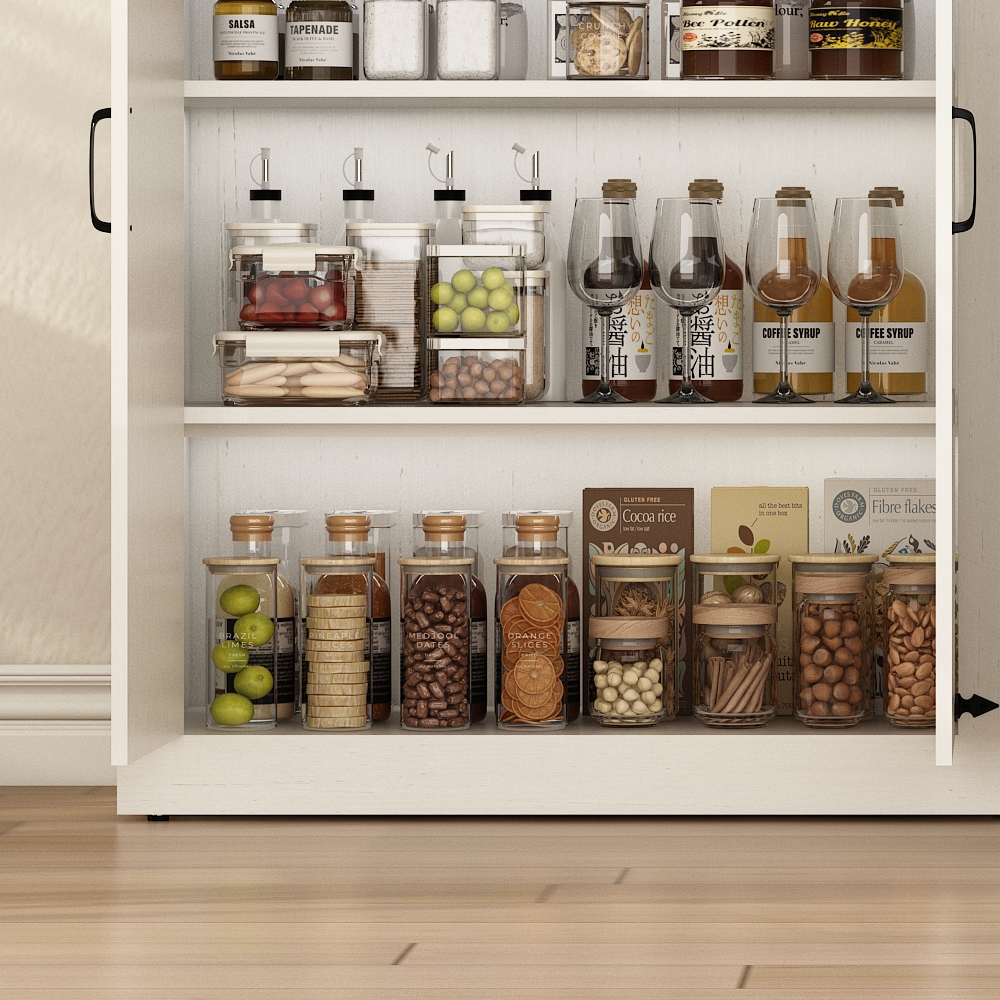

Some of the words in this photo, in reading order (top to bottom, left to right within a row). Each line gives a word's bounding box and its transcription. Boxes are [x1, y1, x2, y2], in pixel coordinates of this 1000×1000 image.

[775, 4, 803, 18] lour;
[228, 20, 255, 28] SALSA
[290, 24, 338, 35] TAPENADE
[578, 22, 633, 30] CRUNCHY
[683, 20, 705, 28] Bee
[710, 19, 766, 28] Pollen
[810, 20, 839, 28] Raw
[844, 18, 897, 30] Honey
[628, 295, 645, 342] 想いの
[644, 294, 656, 346] たまご
[714, 295, 732, 342] 想いの
[762, 328, 791, 338] COFFE
[792, 328, 820, 338] SYRUP
[856, 328, 884, 338] CFEE
[886, 328, 914, 338] SYRUP
[872, 498, 902, 514] Fibre
[904, 498, 936, 514] flakes
[622, 509, 655, 522] Cocoa
[658, 509, 676, 522] rice
[836, 510, 864, 522] ORGANIC
[592, 520, 616, 530] ORGANIC
